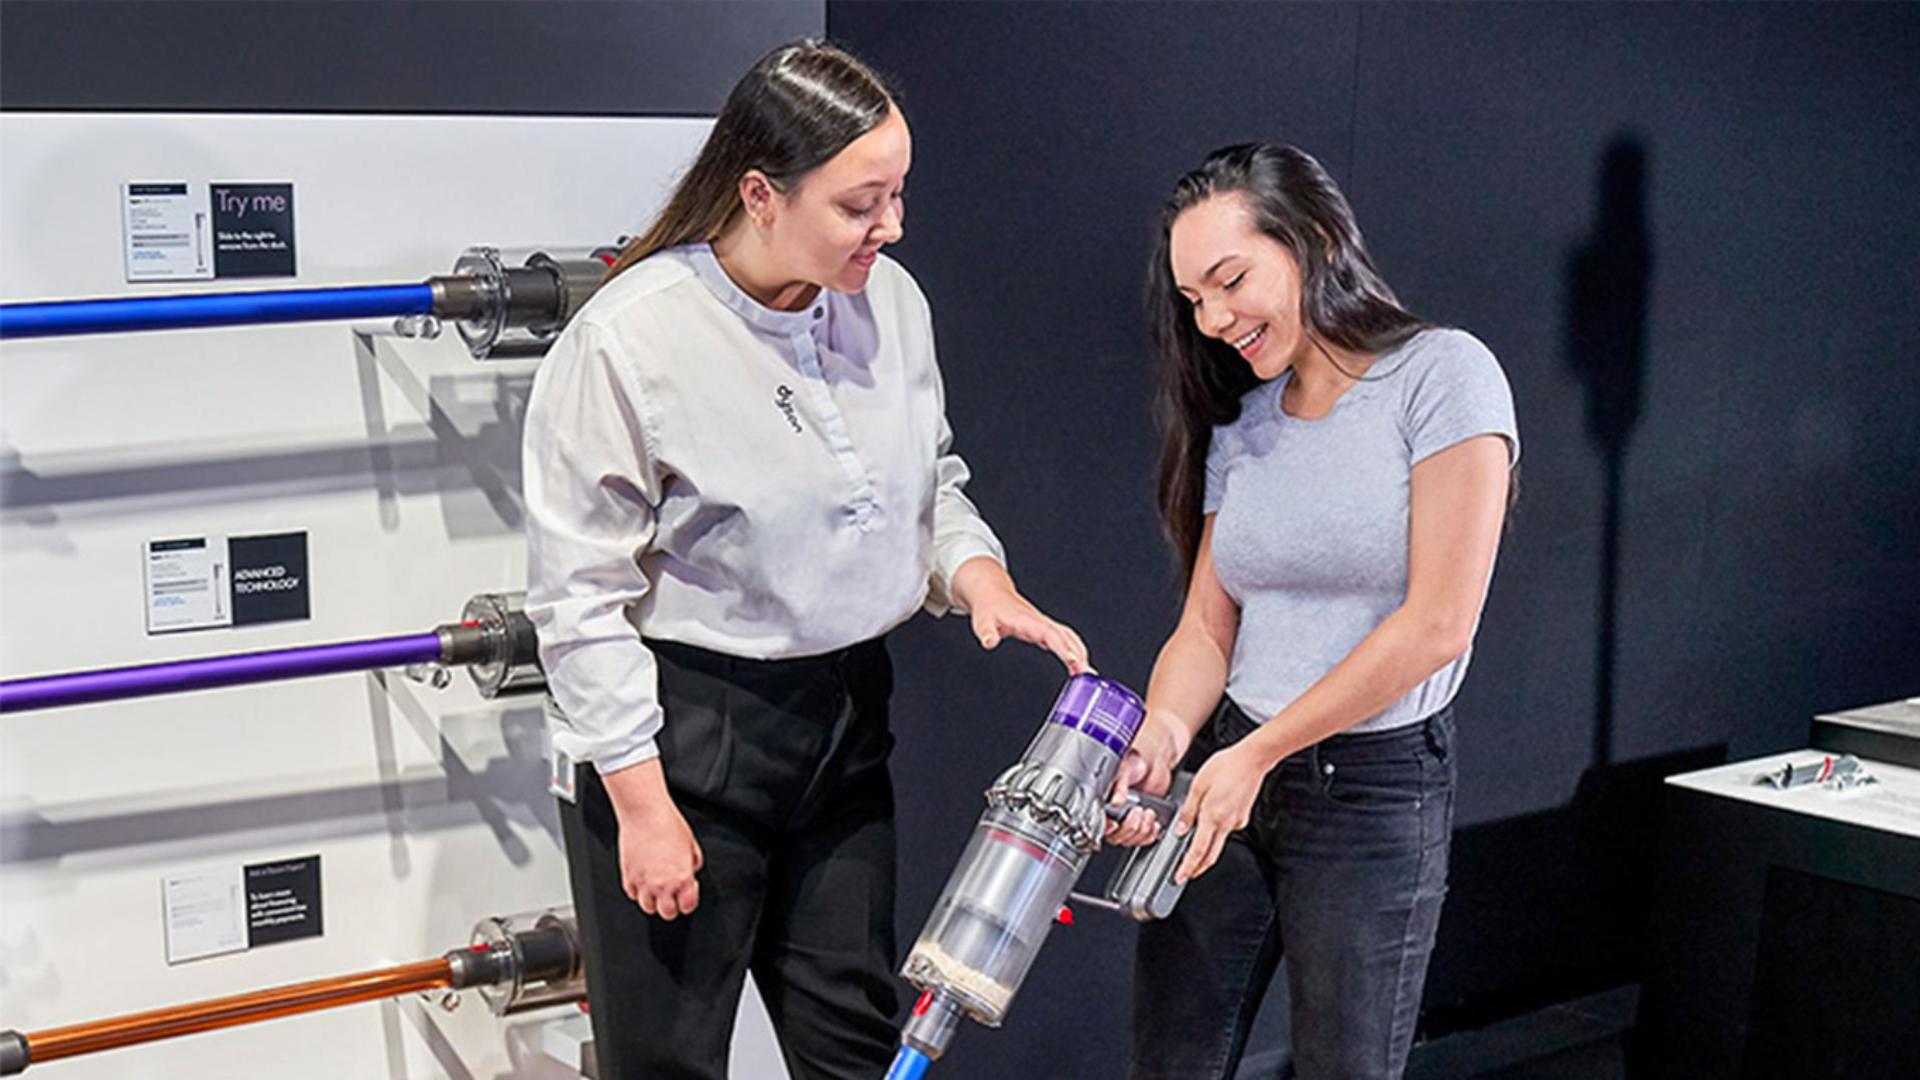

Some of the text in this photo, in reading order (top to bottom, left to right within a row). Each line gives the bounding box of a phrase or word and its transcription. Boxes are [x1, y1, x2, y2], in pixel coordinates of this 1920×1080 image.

[216, 189, 286, 218] Try me
[774, 384, 802, 434] dyson
[235, 565, 286, 580] ADVANCED
[235, 576, 299, 593] TECHNOLOGY
